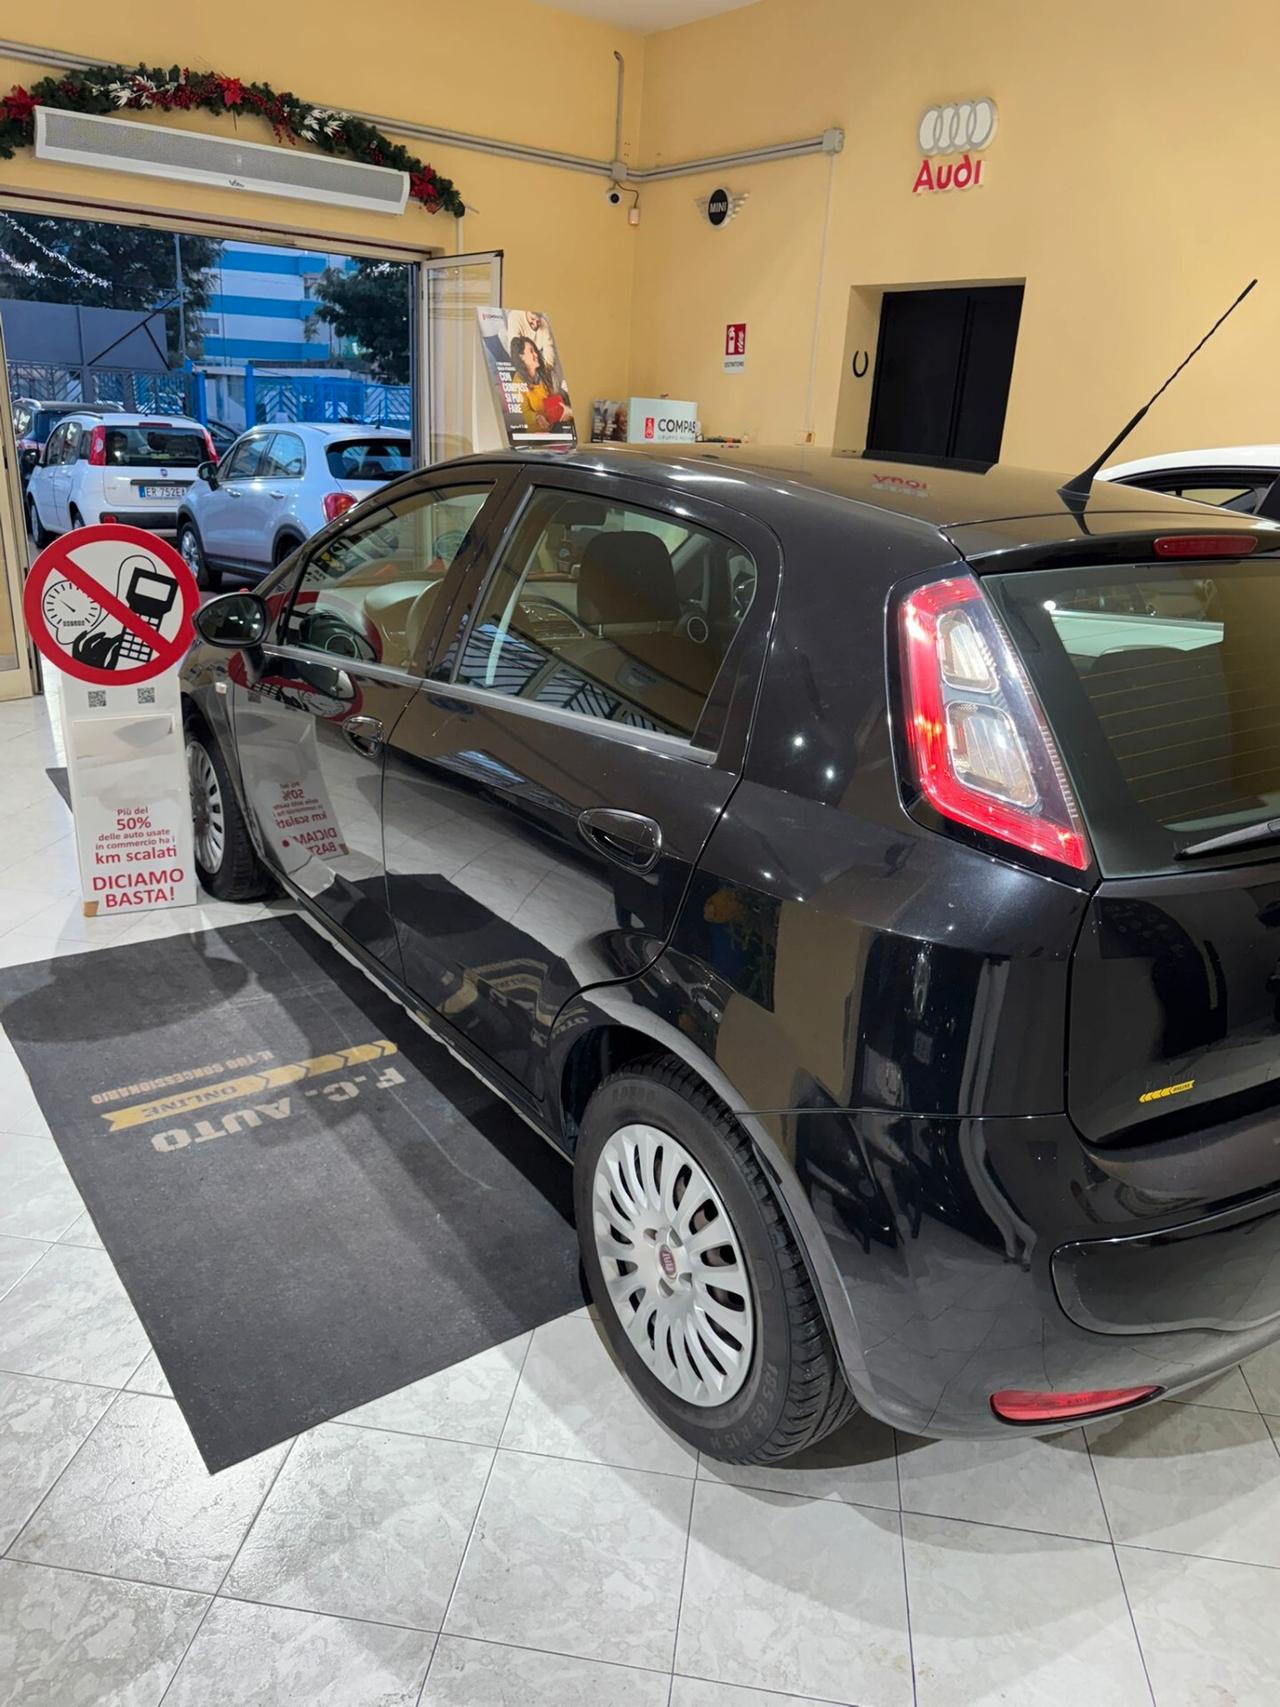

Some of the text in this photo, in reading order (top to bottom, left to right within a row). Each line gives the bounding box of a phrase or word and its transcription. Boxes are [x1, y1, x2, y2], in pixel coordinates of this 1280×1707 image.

[912, 154, 982, 193] Audi
[710, 201, 727, 213] MINI
[117, 806, 148, 816] Più del
[117, 816, 151, 831] 50%
[98, 828, 170, 841] delle auto usate
[106, 838, 157, 850] commercio
[159, 836, 170, 845] ha
[95, 845, 177, 865] km scalati
[92, 868, 185, 891] DICIAMO
[105, 886, 175, 908] BASTA!
[90, 1063, 225, 1104] CONCESSIONARIO
[141, 1085, 238, 1118] ONLINE
[151, 1097, 291, 1152] AUTO
